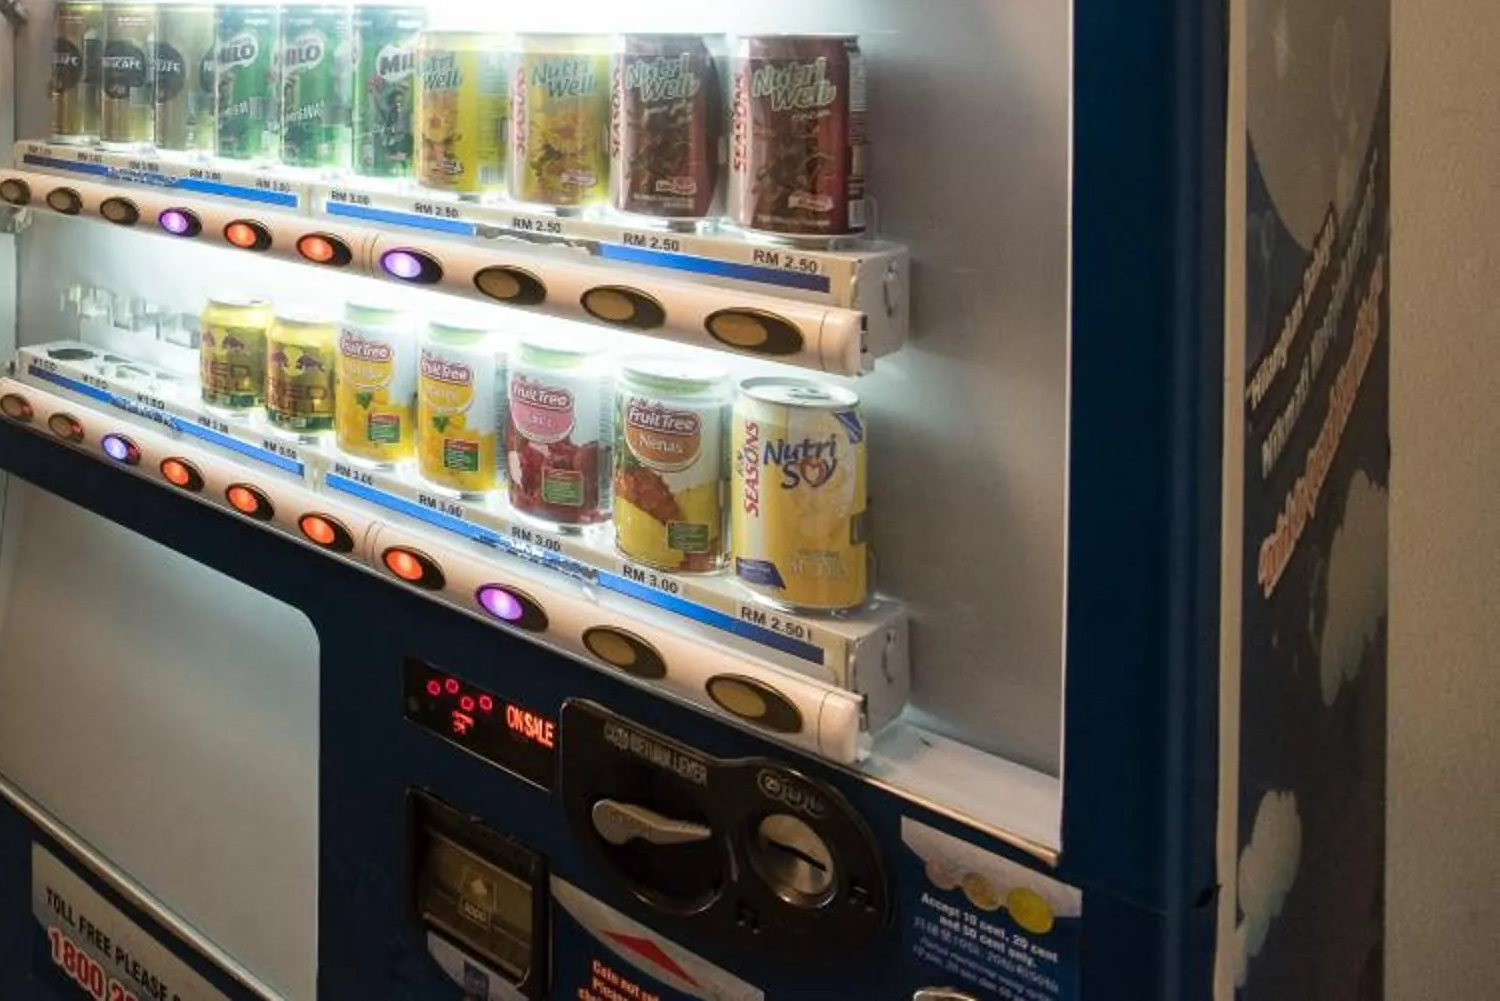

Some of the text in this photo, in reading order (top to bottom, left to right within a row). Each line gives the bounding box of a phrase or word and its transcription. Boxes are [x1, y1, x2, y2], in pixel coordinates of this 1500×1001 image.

[414, 203, 433, 215] RM
[513, 217, 562, 234] RM 2.50
[623, 232, 680, 252] RM 2.50
[753, 249, 818, 274] RM 2.50
[763, 434, 837, 467] Nutri
[743, 421, 760, 518] SEASONS
[418, 494, 437, 509] RM
[511, 526, 562, 551] RM 3.00
[622, 564, 678, 594] RM 3.00
[740, 606, 804, 639] RM 2.50
[45, 887, 169, 1000] TOLL FREE PLEASE
[48, 925, 108, 1000] 1800
